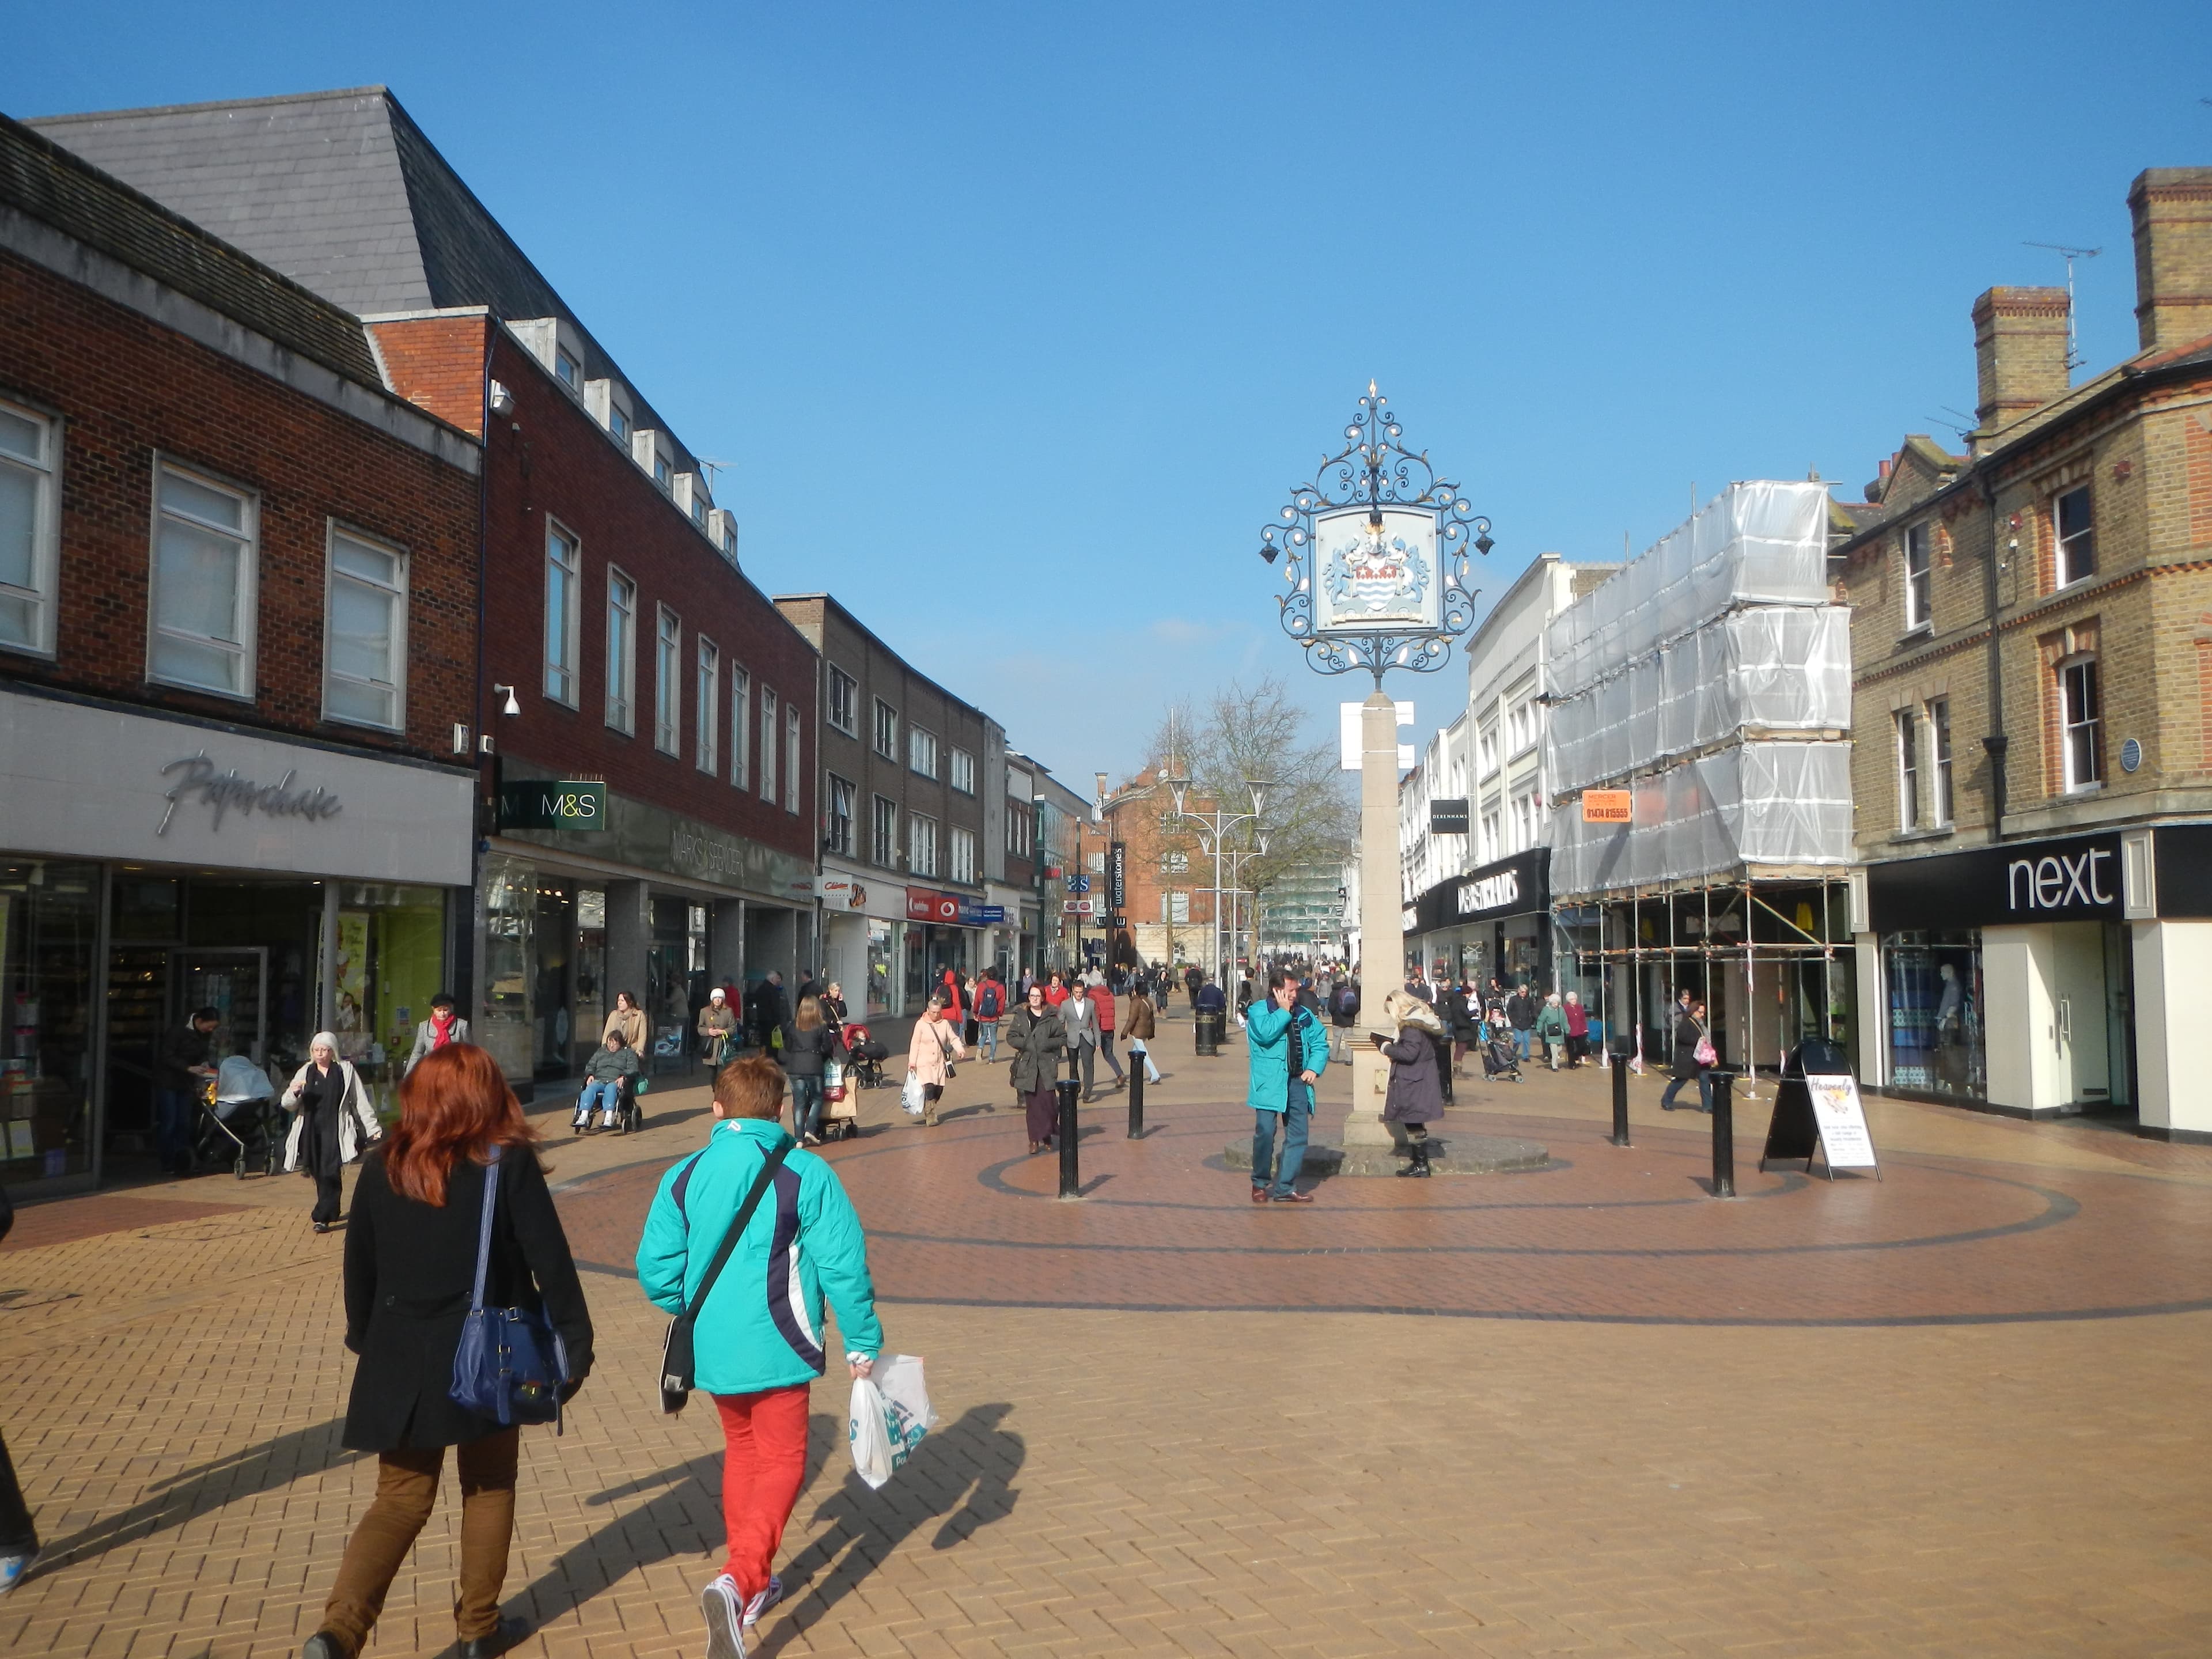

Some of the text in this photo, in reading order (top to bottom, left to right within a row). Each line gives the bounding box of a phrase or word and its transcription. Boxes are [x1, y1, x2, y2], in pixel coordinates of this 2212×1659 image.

[158, 749, 343, 835] Paperchase
[541, 794, 596, 817] M&S
[1114, 848, 1122, 904] waterstone's
[2009, 847, 2113, 910] next
[1810, 1077, 1853, 1096] Heavenly
